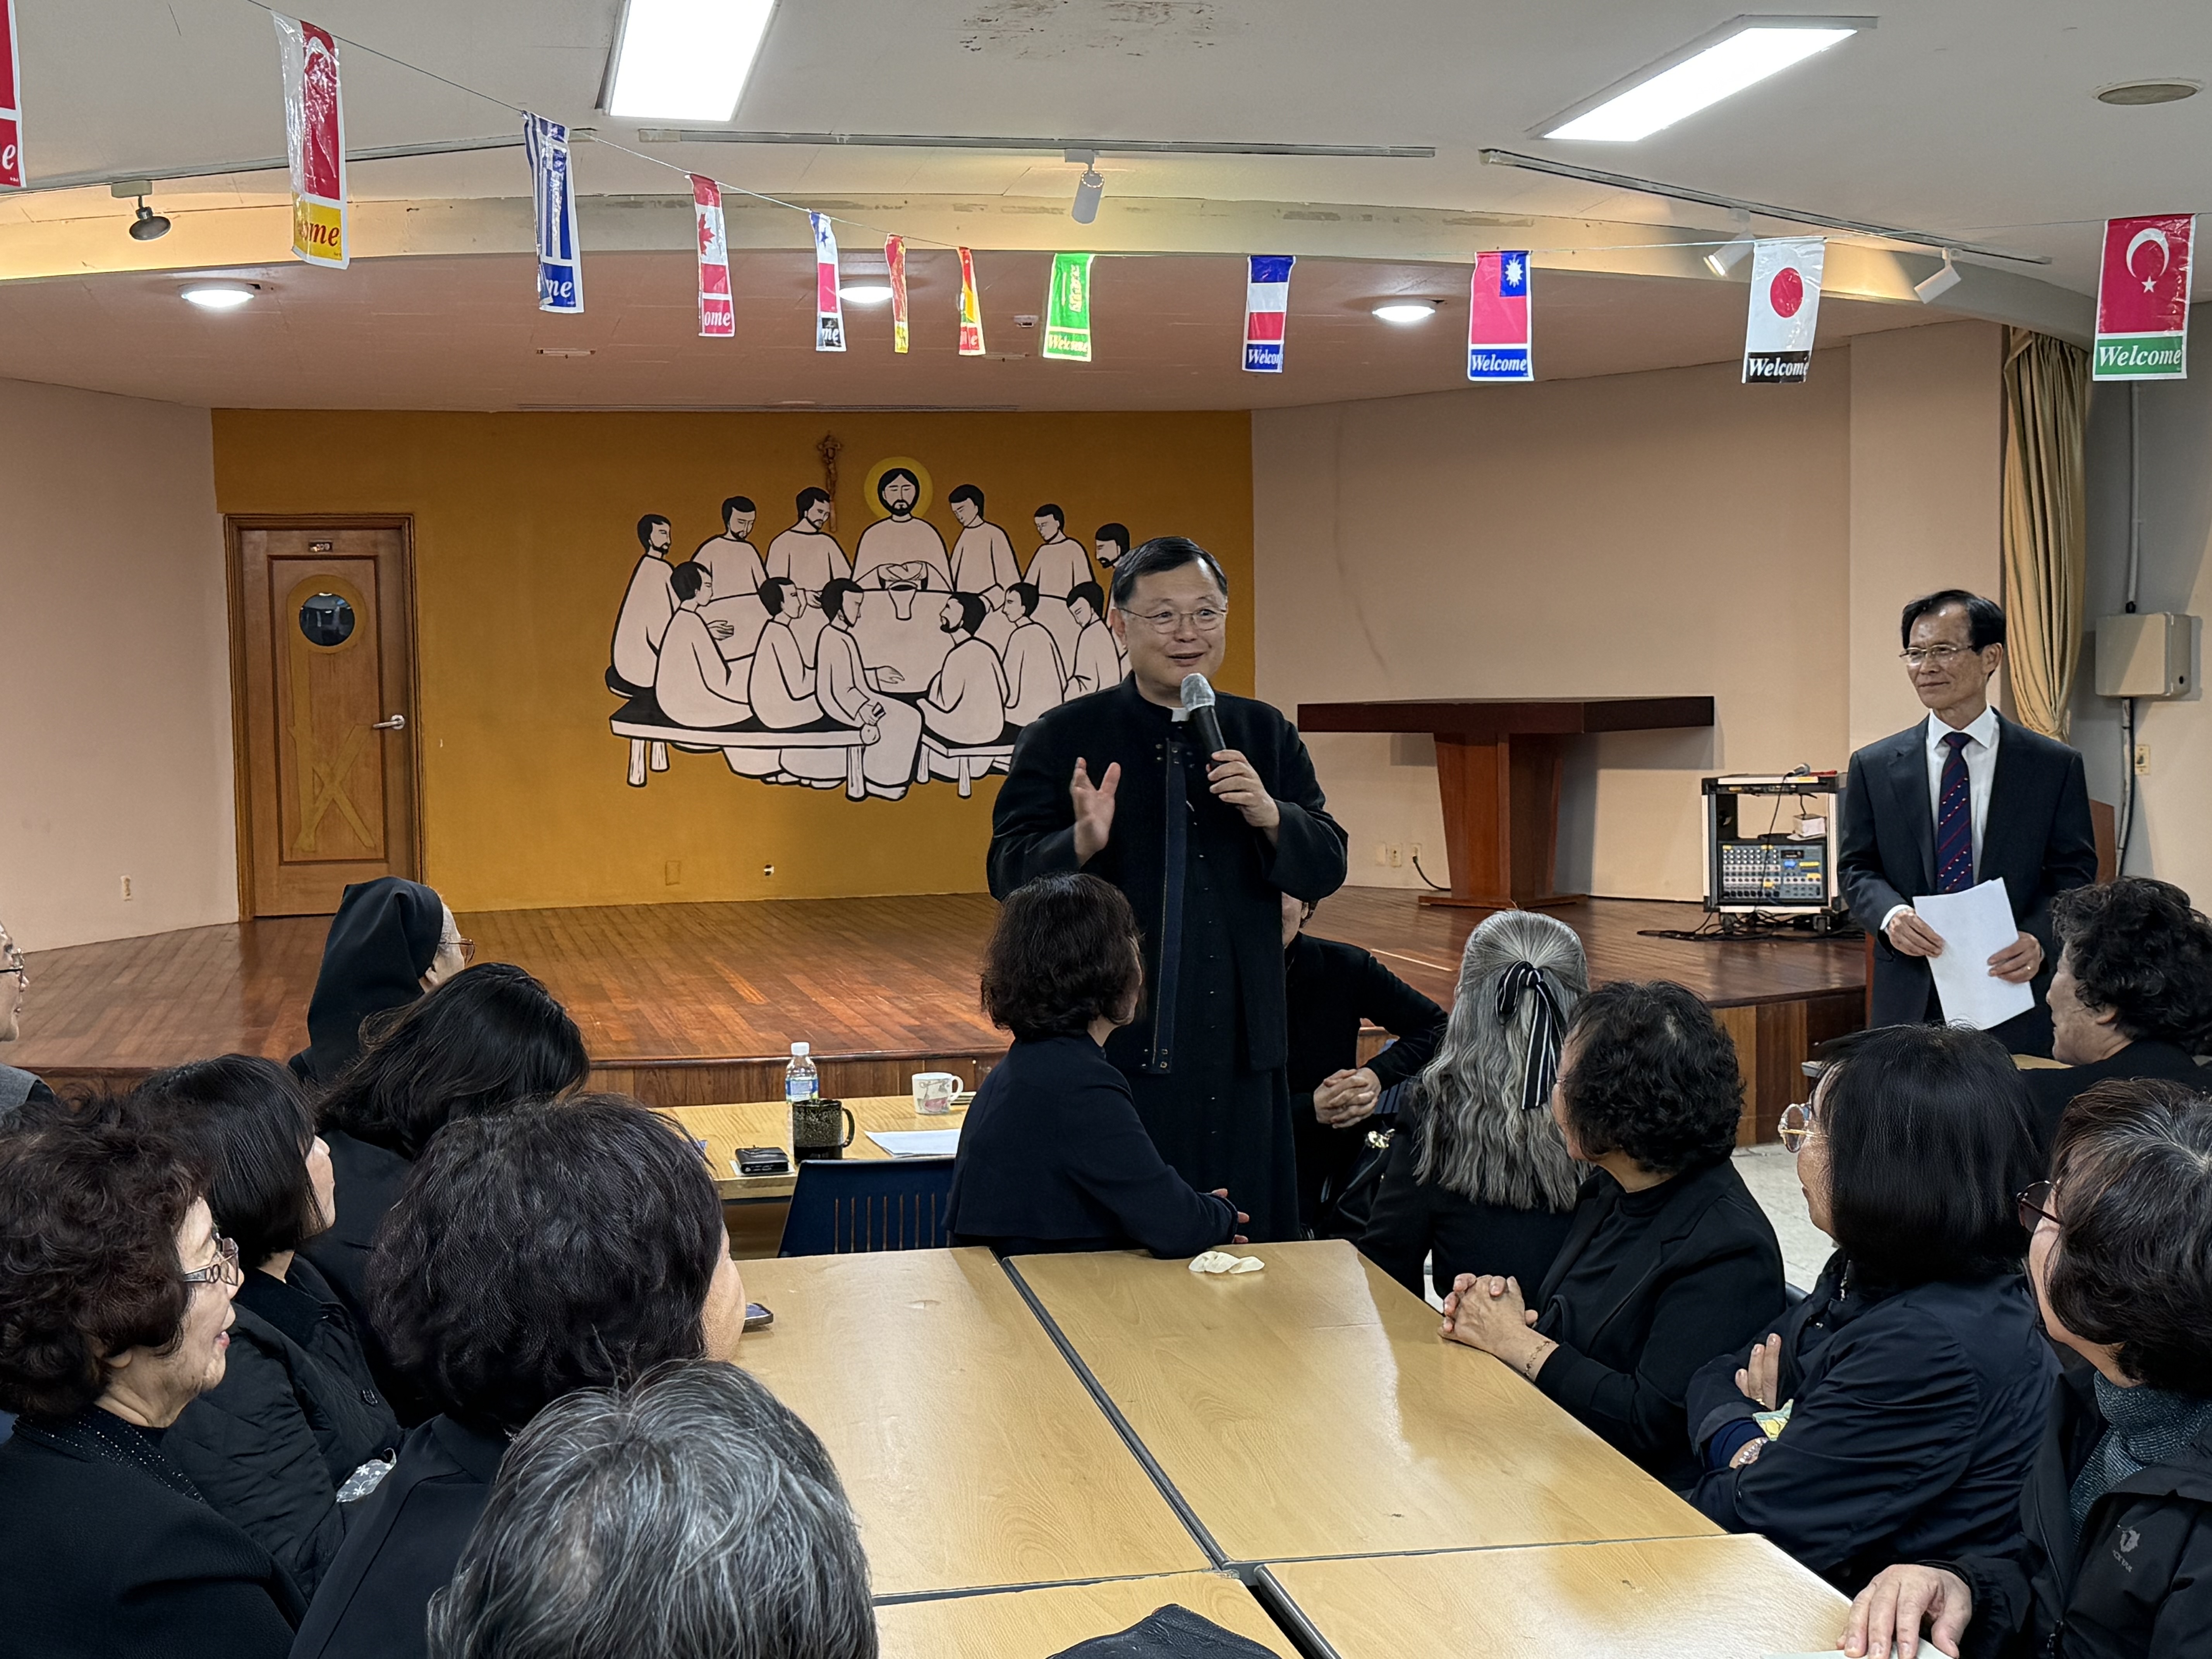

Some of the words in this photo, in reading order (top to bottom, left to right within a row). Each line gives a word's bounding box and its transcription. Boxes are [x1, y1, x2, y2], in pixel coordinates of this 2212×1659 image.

[1472, 354, 1527, 371] Welcome
[2099, 345, 2182, 366] Welcome
[1749, 357, 1809, 376] Welcome
